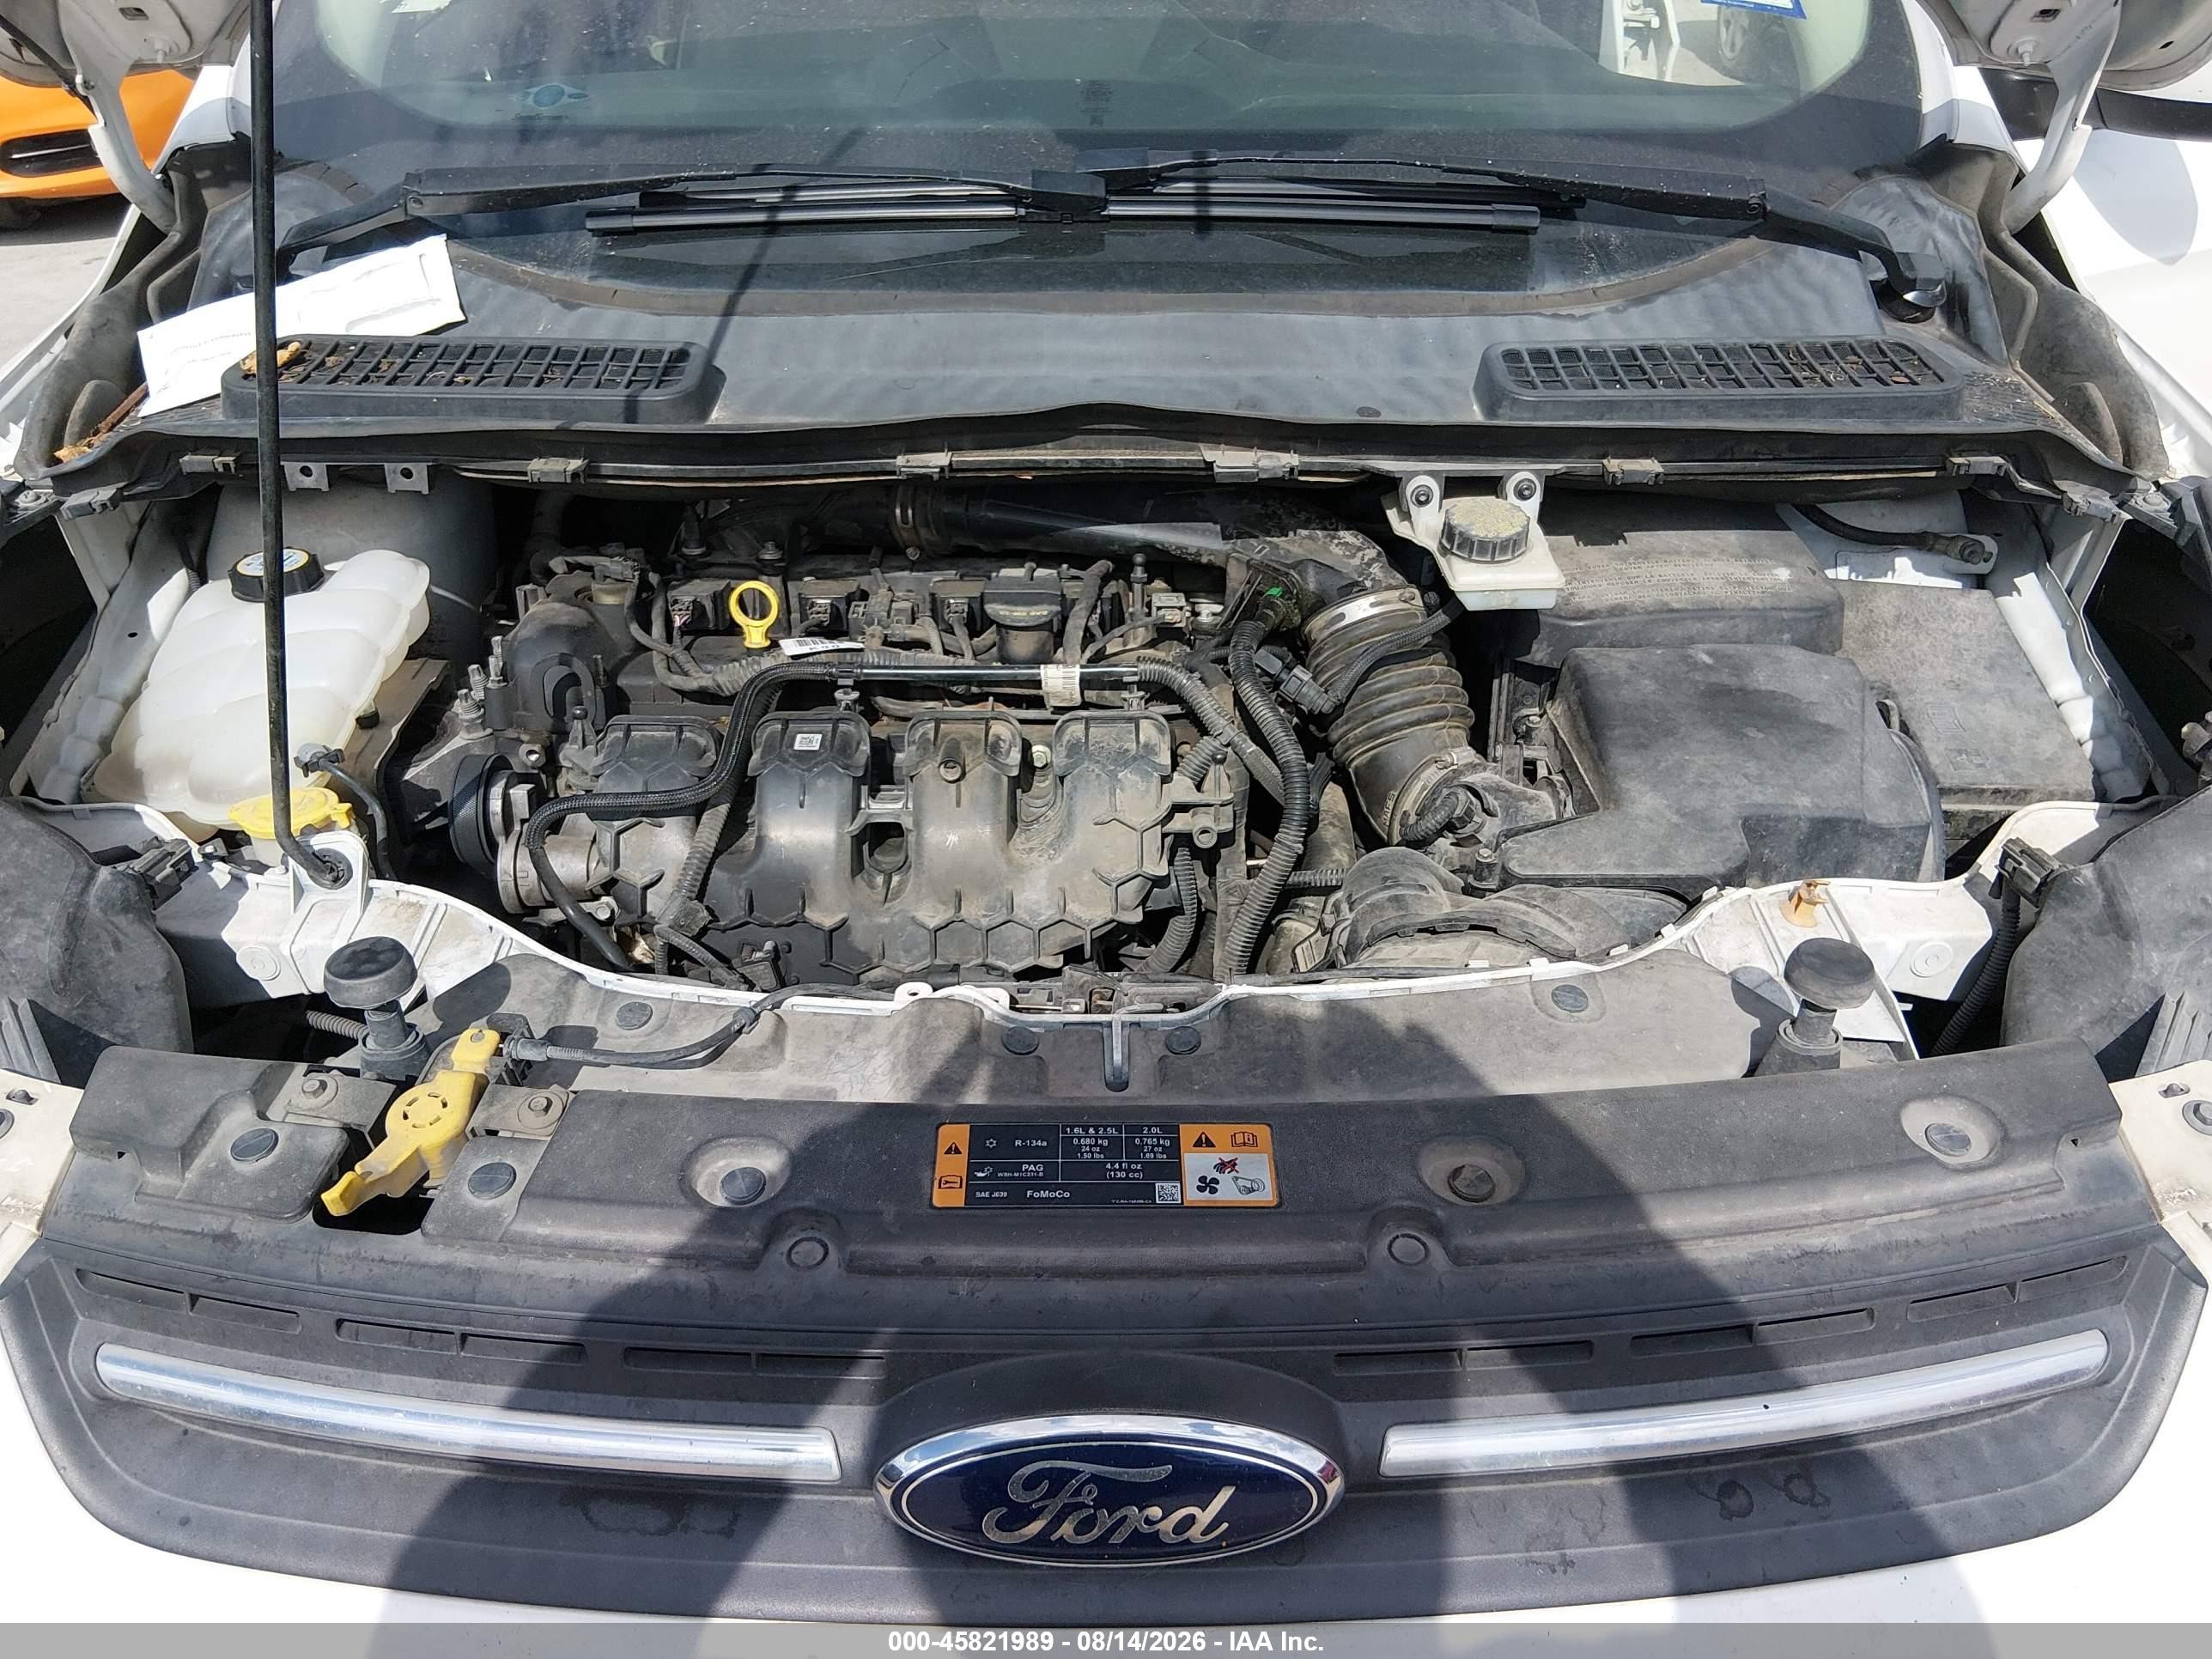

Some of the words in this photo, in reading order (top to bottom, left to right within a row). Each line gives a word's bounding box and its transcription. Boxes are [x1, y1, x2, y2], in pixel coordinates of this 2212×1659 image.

[1097, 1138, 1109, 1146] kg
[1159, 1138, 1170, 1146] kg
[1022, 1164, 1044, 1172] PAG
[1106, 1170, 1127, 1179] (130
[1128, 1170, 1143, 1179] cc)
[1026, 1189, 1071, 1199] FoMoCo
[981, 1459, 1237, 1544] Ford
